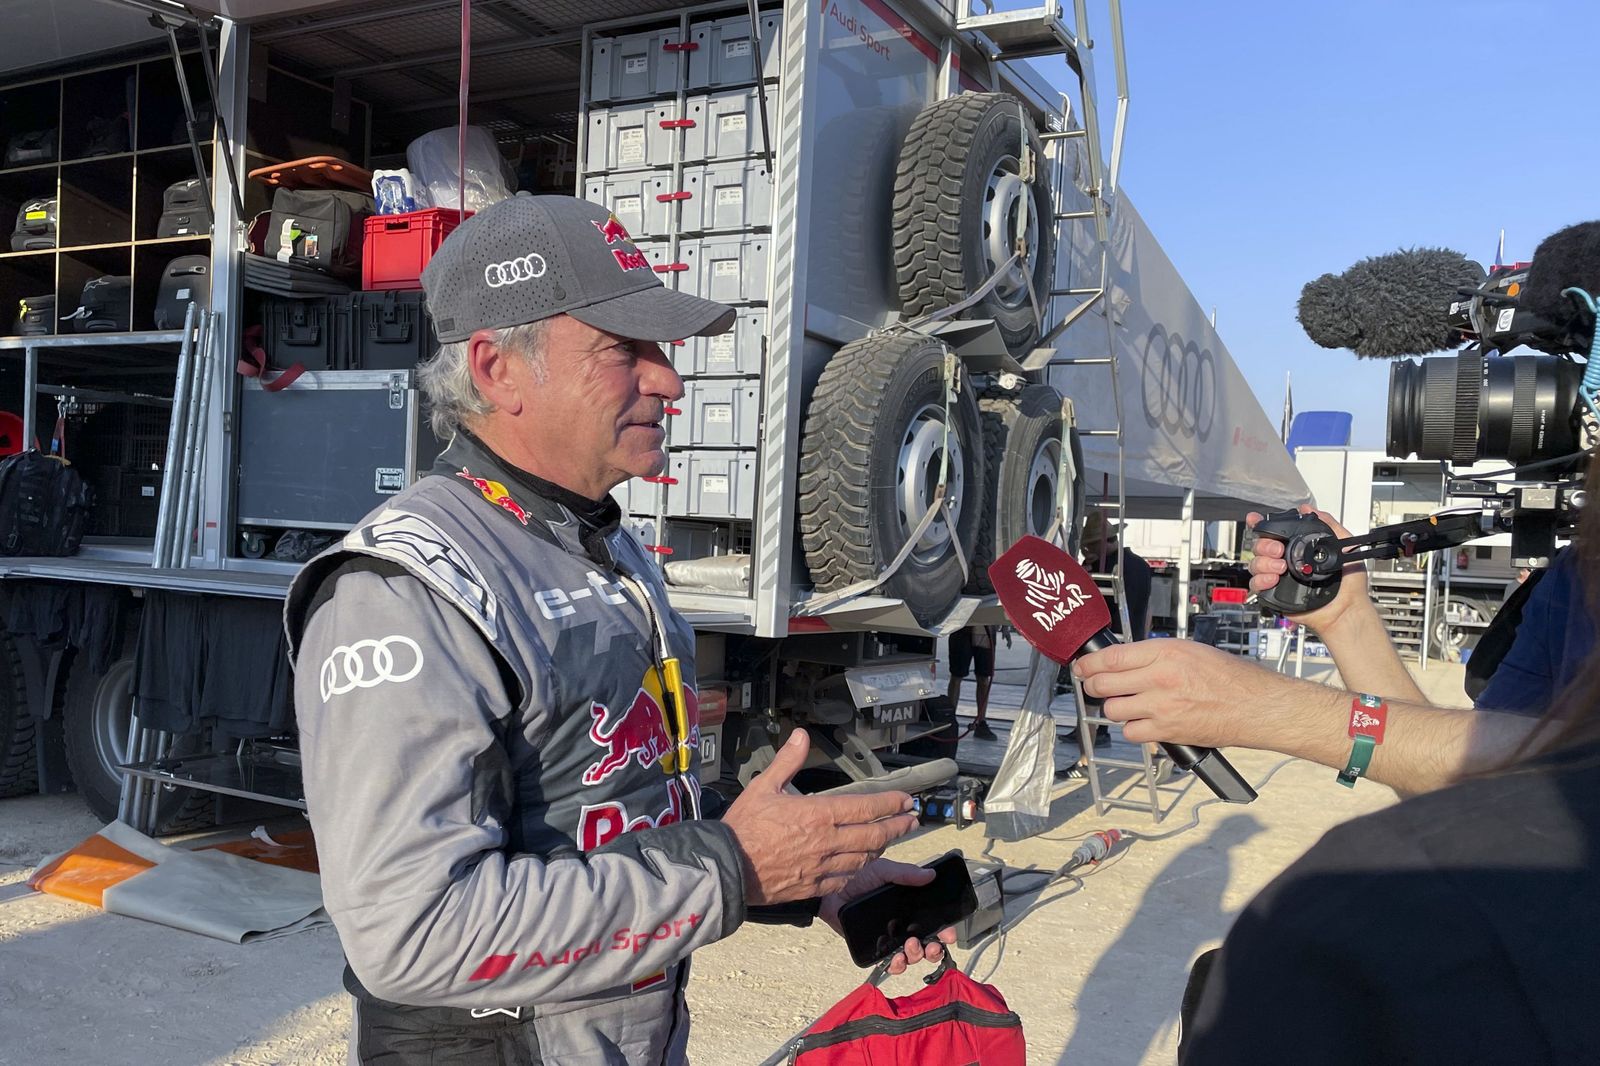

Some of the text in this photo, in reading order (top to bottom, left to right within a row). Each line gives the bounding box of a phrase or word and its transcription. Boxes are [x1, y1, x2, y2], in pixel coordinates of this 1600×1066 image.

[829, 2, 890, 61] Audi Sport
[1032, 584, 1092, 631] DAKAR
[881, 706, 913, 723] MAN
[522, 913, 701, 971] Audi Sport
